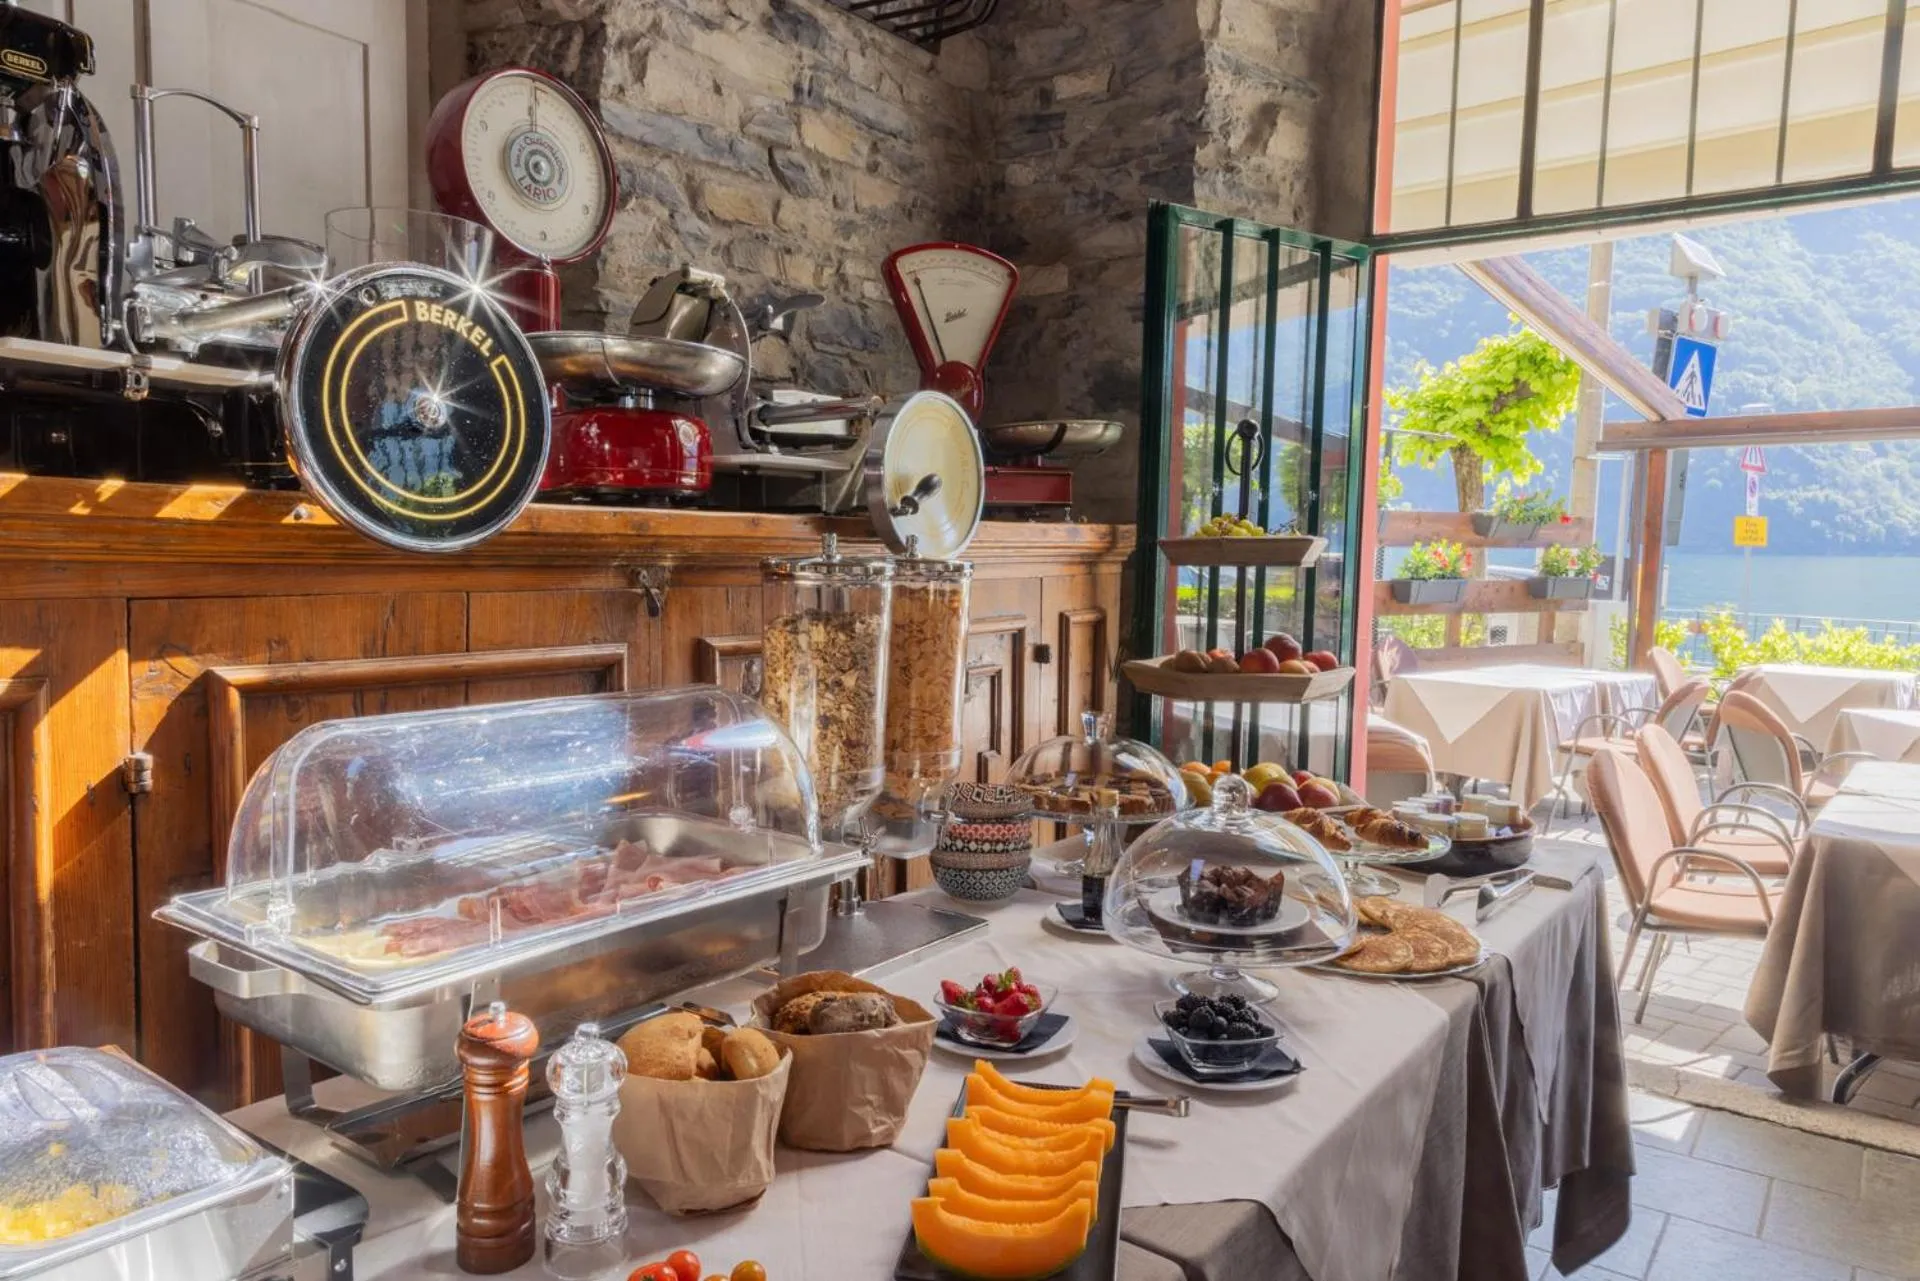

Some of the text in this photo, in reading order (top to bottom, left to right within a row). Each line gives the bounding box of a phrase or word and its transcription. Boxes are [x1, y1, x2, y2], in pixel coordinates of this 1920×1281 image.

[7, 53, 43, 70] BERKEL
[518, 175, 558, 201] LARIO
[414, 300, 494, 357] BERKEL
